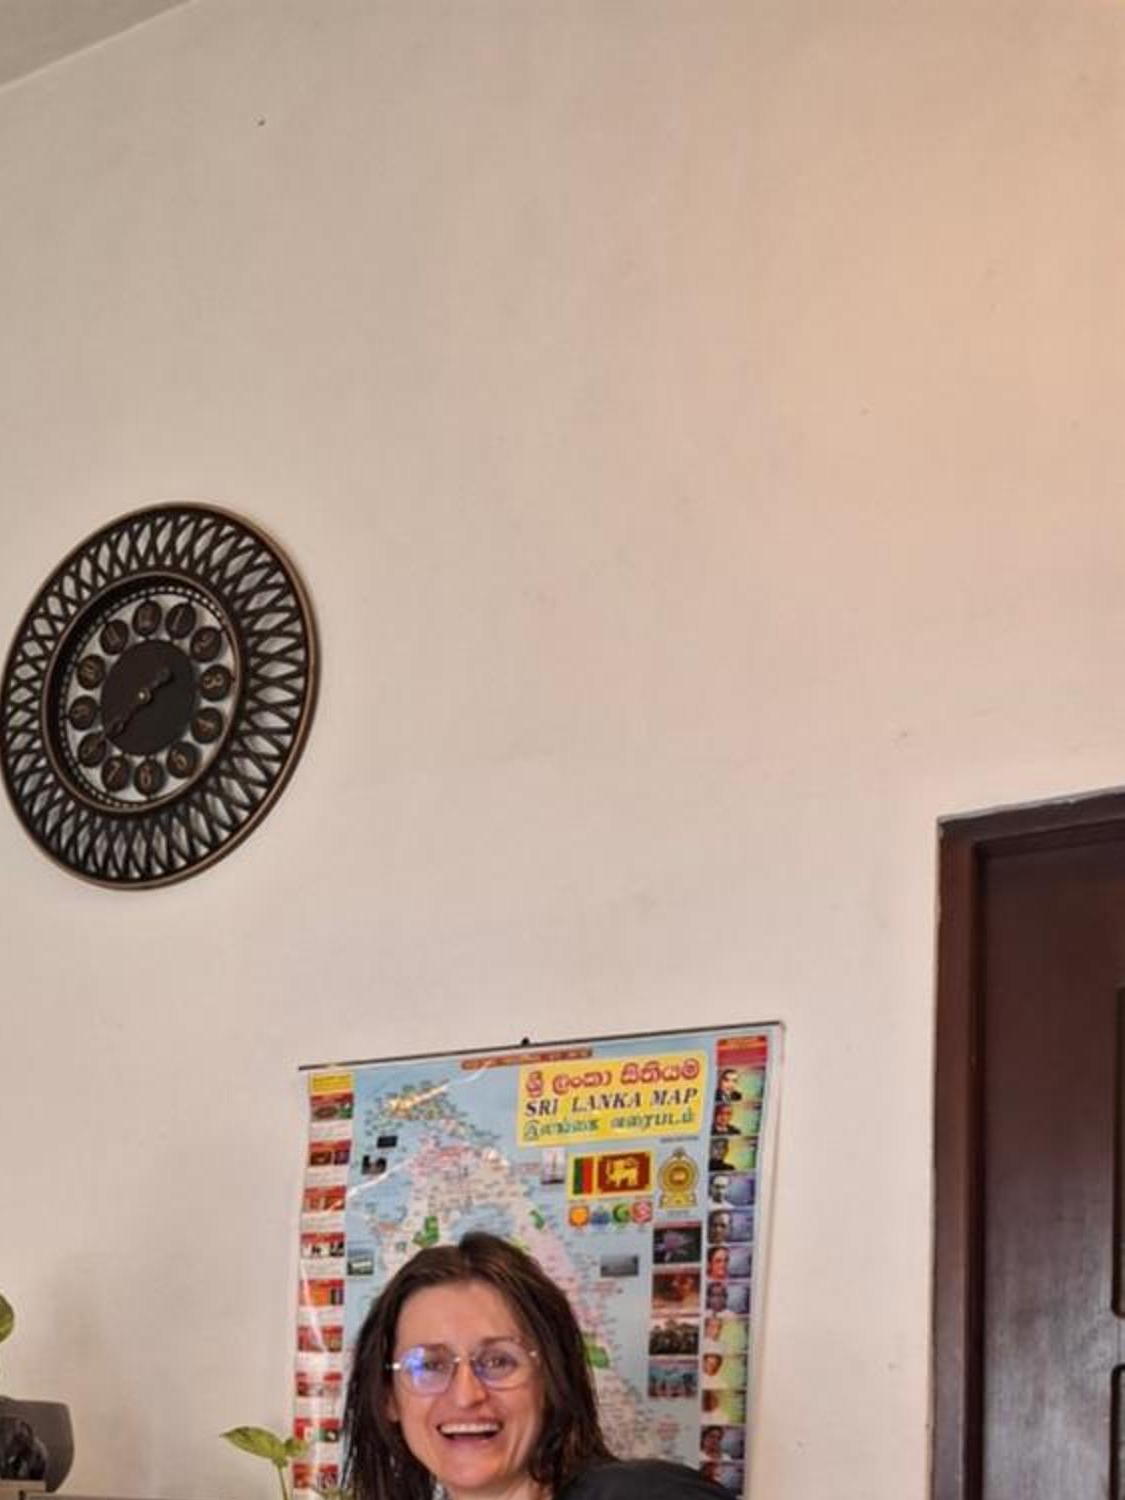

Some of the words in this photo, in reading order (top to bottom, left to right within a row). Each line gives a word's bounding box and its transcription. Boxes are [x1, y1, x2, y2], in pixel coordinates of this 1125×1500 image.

[552, 1070, 613, 1095] ලංකා
[525, 1099, 558, 1116] SRI
[572, 1092, 642, 1112] LANKA
[650, 1087, 698, 1105] MAP
